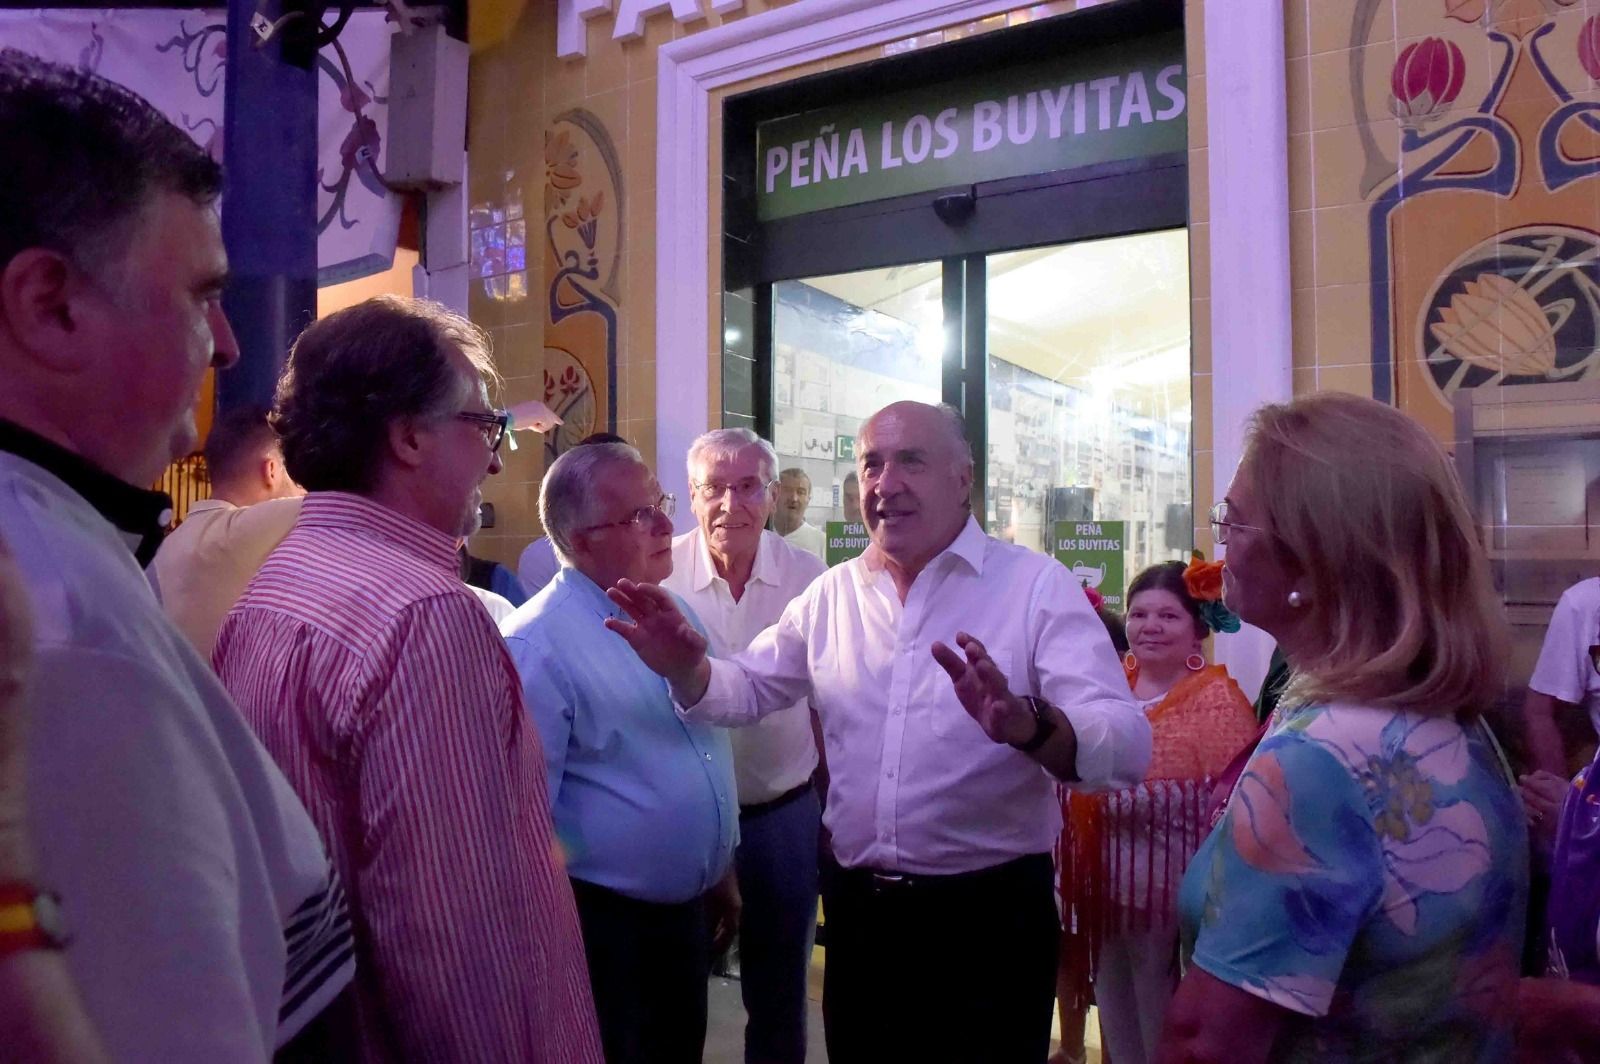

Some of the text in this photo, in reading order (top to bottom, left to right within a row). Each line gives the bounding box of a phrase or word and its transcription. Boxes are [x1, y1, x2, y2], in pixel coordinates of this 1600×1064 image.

[766, 64, 1185, 193] PEÑA LOS BUYITAS
[843, 523, 864, 535] PEÑA
[1076, 522, 1102, 535] PEÑA
[830, 538, 871, 548] LOS BUYIT
[1059, 539, 1120, 550] LOS BUYITAS
